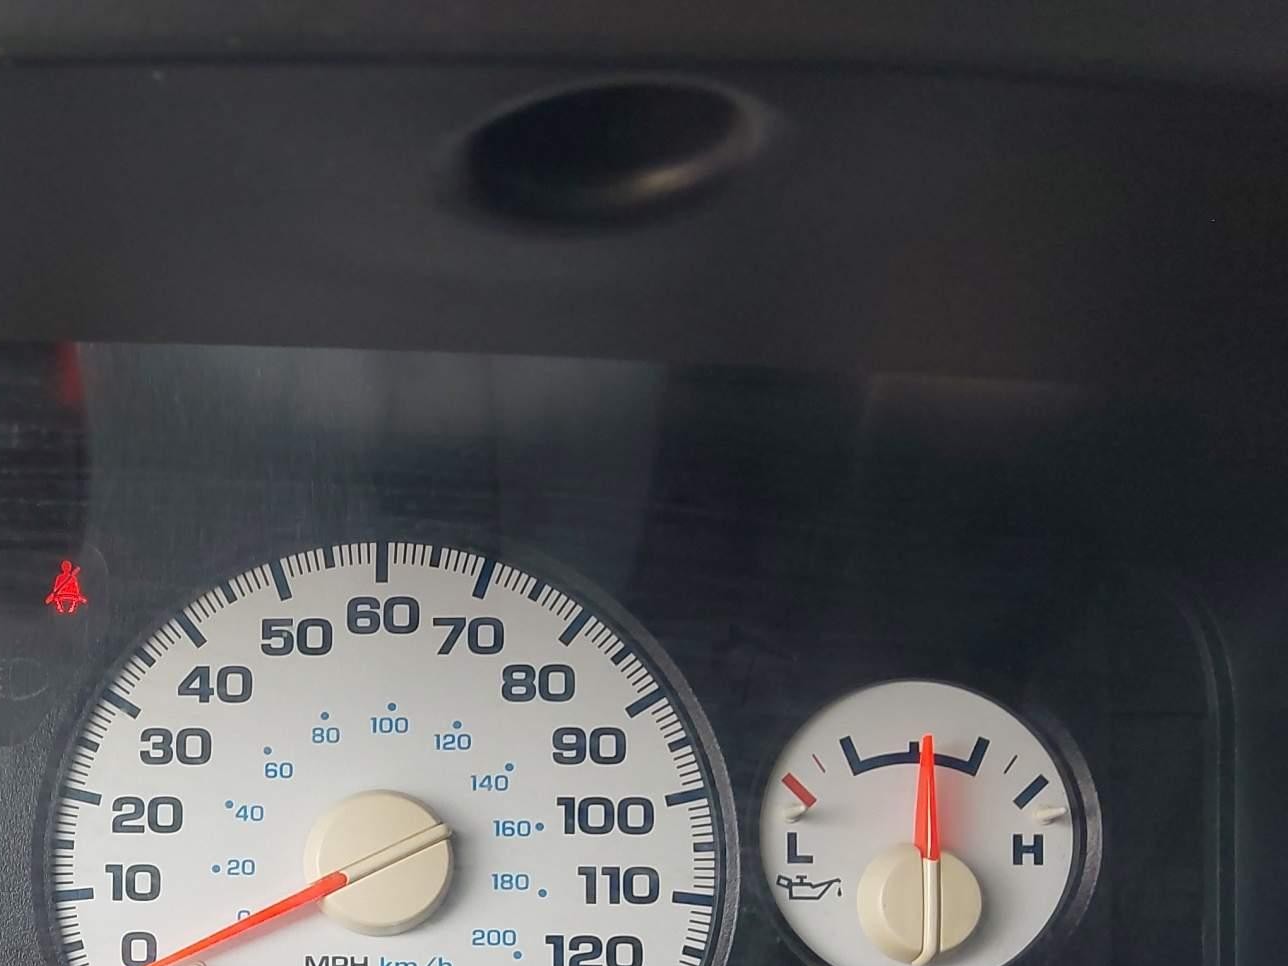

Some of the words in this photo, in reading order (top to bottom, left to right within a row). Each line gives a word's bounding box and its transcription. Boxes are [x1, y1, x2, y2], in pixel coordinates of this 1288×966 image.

[347, 596, 420, 634] 60
[260, 618, 333, 656] 50
[432, 616, 504, 655] 70
[177, 665, 253, 703] 40
[500, 663, 575, 702] 80
[311, 726, 340, 744] 80
[370, 716, 409, 734] 100
[139, 727, 212, 765] 30
[433, 733, 472, 751] 120
[551, 726, 626, 765] 90
[264, 762, 293, 779] 60
[470, 774, 510, 792] 140
[110, 796, 183, 835] 20
[235, 804, 264, 822] 40
[492, 819, 531, 837] 160
[557, 796, 654, 836] 100
[787, 832, 813, 864] L
[1012, 833, 1043, 866] H
[105, 863, 162, 902] 10
[226, 858, 256, 877] 20
[491, 873, 529, 891] 180
[577, 866, 660, 904] 110
[471, 929, 516, 948] 200
